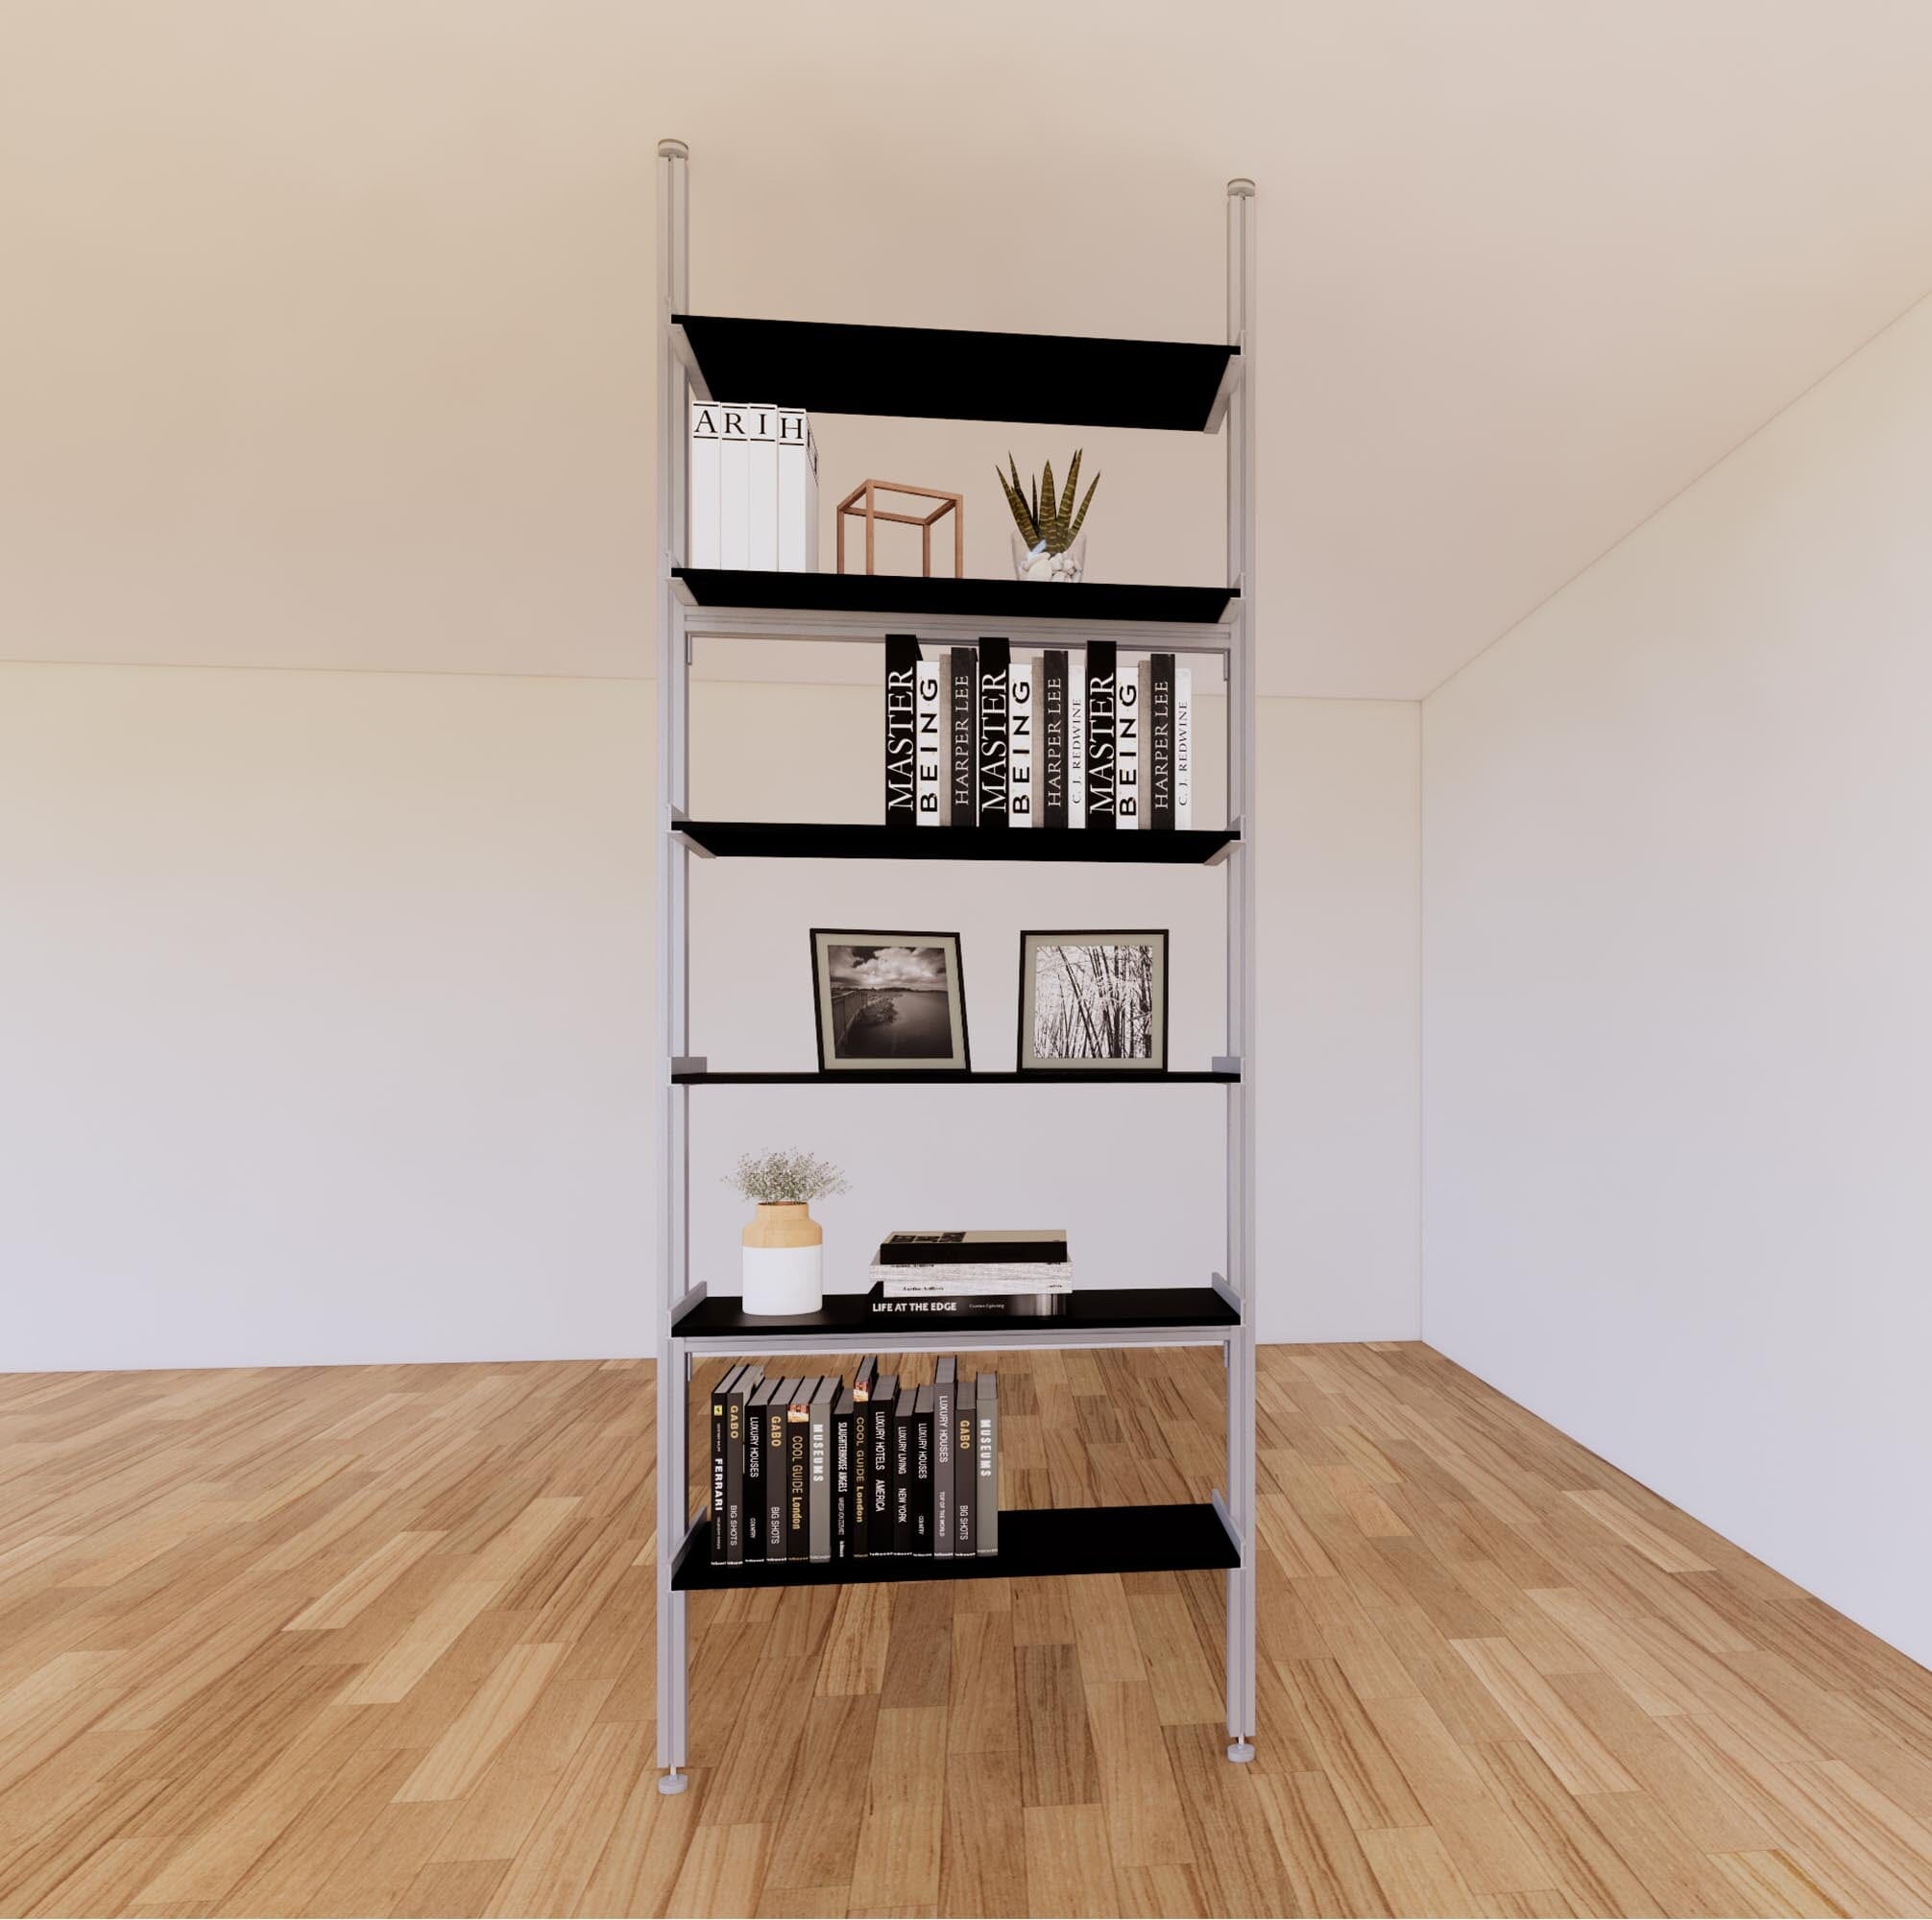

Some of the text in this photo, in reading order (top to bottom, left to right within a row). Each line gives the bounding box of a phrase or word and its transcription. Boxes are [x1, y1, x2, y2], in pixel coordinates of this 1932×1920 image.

[888, 666, 913, 810] MASTER
[920, 678, 938, 813] BEING
[955, 675, 969, 805] HARPER LEE
[981, 669, 1006, 813] MASTER
[1012, 681, 1030, 814] BEING
[1048, 677, 1061, 807] HARPER LEE
[1072, 699, 1081, 804] C. J. REDWINE
[1089, 673, 1115, 815] MASTER
[1119, 684, 1137, 816] BEING
[1154, 681, 1169, 809] HARPER LEE
[1178, 701, 1188, 806] C. J. REDWINE
[873, 1302, 956, 1312] LIFE AT THE EDGE
[730, 1404, 738, 1439] GABO
[750, 1416, 759, 1445] LUXURY
[812, 1424, 824, 1482] MUSEUMS
[838, 1422, 848, 1471] SLAUGHTERHOUSE
[918, 1423, 928, 1450] LUXURY
[939, 1396, 949, 1427] LUXURY
[939, 1429, 949, 1463] HOUSES
[980, 1419, 992, 1477] MUSEUMS
[714, 1458, 723, 1511] FERRARI
[749, 1447, 759, 1477] HOUSES
[771, 1416, 781, 1545] GABO BIG SHOTS
[791, 1435, 803, 1529] COOL GUIDE London
[837, 1472, 848, 1493] ANGELS
[856, 1416, 864, 1523] COOL GUIDE London
[875, 1411, 885, 1512] LUXURY HOTELS AMERICA
[898, 1427, 906, 1523] LUXURY LIVING NEW YORK
[918, 1451, 928, 1479] HOUSES
[960, 1420, 970, 1541] GABO BIG SHOTS
